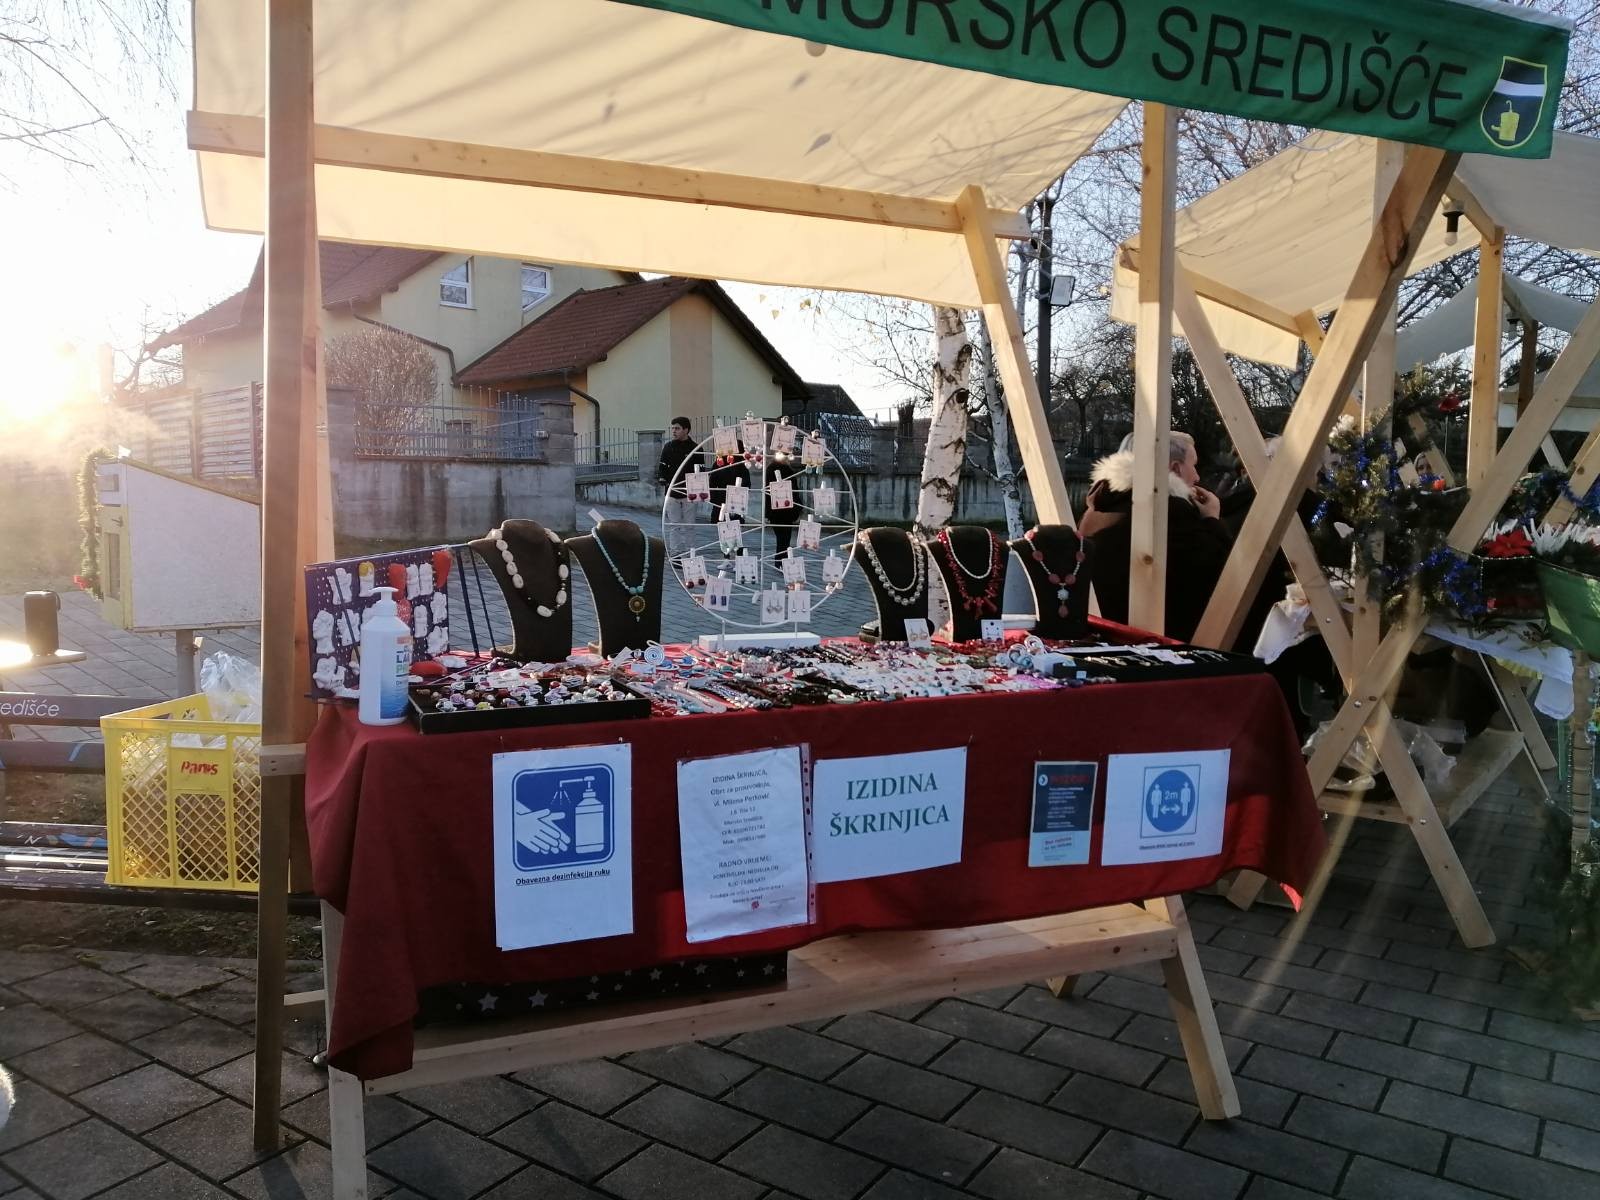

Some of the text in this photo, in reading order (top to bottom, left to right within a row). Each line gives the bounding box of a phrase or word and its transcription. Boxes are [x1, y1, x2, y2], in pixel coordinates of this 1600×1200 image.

[761, 0, 1468, 128] RSKO SREDIŠĆE
[0, 699, 60, 717] edišće
[846, 772, 938, 801] IZIDINA
[829, 804, 951, 838] ŠKRINJICA
[515, 867, 611, 886] Obavezna dezinfekcija ruku
